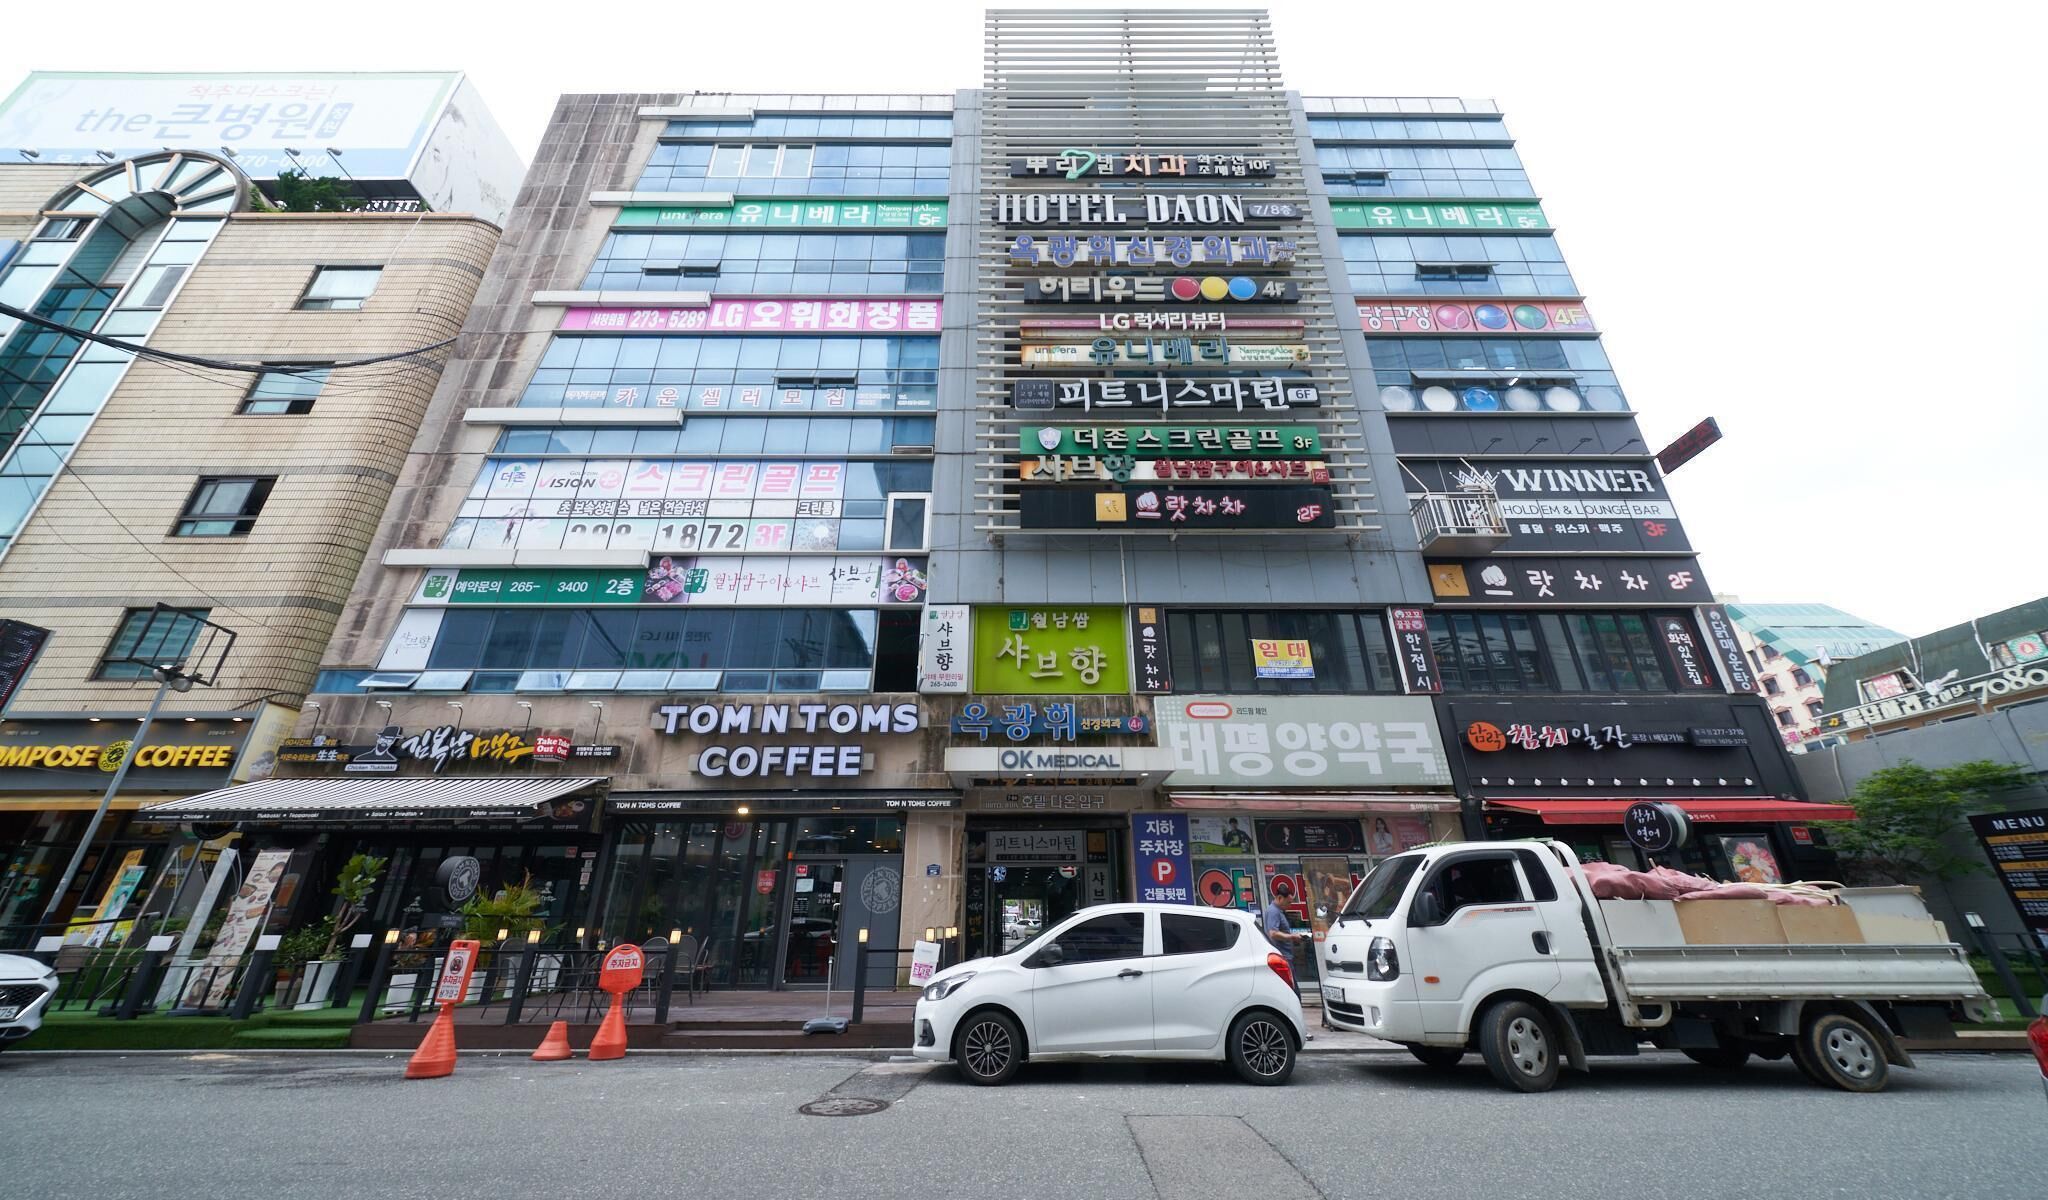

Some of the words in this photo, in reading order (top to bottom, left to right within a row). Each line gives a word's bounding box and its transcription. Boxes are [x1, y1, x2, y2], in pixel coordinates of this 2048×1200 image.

[1125, 154, 1188, 176] 치과
[1247, 160, 1271, 170] 10F
[736, 203, 872, 224] 유니베라
[998, 194, 1127, 223] HOTEL
[1146, 194, 1245, 223] DAON
[1253, 205, 1292, 215] 7/8층
[1371, 206, 1504, 226] 유니베라
[919, 213, 941, 226] 5F
[1517, 217, 1538, 229] 5F
[1039, 276, 1167, 302] 허리우드
[1261, 281, 1286, 298] 4F
[1101, 313, 1130, 332] LG
[1134, 312, 1187, 332] 럭셔리
[1190, 312, 1227, 332] 뷰티
[1358, 305, 1432, 331] 당구장
[1553, 307, 1586, 327] 4F
[1088, 336, 1231, 365] 유니베라
[1059, 376, 1290, 414] 피트니스마틴
[1295, 389, 1311, 399] 6F
[1293, 435, 1313, 449] 3F
[629, 462, 842, 495] 스크린골프
[1033, 454, 1136, 484] 샤브향
[1313, 471, 1327, 481] 2F
[538, 477, 596, 489] VISION
[1501, 468, 1656, 492] WINNER
[1297, 504, 1323, 523] 2F
[1563, 505, 1573, 515] &
[1575, 505, 1629, 516] LOUNGE
[1633, 505, 1661, 515] BAR
[755, 525, 787, 546] 3F
[1519, 523, 1544, 534] 홀덤
[1555, 523, 1591, 534] 위스키
[1598, 523, 1624, 534] 맥주
[1644, 520, 1669, 537] 3F
[455, 579, 502, 593] 예약문의
[605, 578, 635, 596] 2층
[1668, 571, 1694, 591] 2F
[1031, 611, 1090, 629] 월남쌈
[935, 621, 954, 671] 샤브향
[996, 633, 1108, 685] 샤브향
[1405, 632, 1433, 691] 한접시
[1969, 663, 2048, 705] 7080
[659, 703, 752, 735] TOM
[760, 703, 790, 735] N
[798, 703, 920, 735] TOMS
[958, 702, 1076, 742] 옥광휘
[1080, 718, 1121, 731] 신경외과
[1129, 720, 1143, 731] 4F
[536, 737, 558, 745] Take
[536, 745, 554, 753] Out
[1167, 722, 1439, 777] 태평양약국
[134, 744, 233, 767] COFFEE
[697, 745, 863, 778] COFFEE
[1001, 750, 1034, 770] OK
[1036, 754, 1121, 768] MEDICAL
[616, 801, 630, 809] TOM
[631, 801, 637, 809] N
[638, 801, 656, 809] TOMS
[657, 801, 681, 809] COFFEE
[886, 800, 900, 808] TOM
[901, 800, 907, 808] N
[908, 800, 926, 808] TOMS
[927, 800, 951, 808] COFFEE
[1022, 793, 1047, 809] 호텔
[1079, 793, 1105, 809] 입구
[1631, 808, 1657, 824] 참치
[1991, 815, 2046, 831] MENU
[1146, 819, 1175, 836] 지하
[1636, 826, 1661, 842] 연어
[994, 835, 1078, 852] 피트니스마틴
[1139, 839, 1185, 856] 주차장
[1157, 861, 1172, 881] P
[1144, 887, 1187, 901] 건물뒷편
